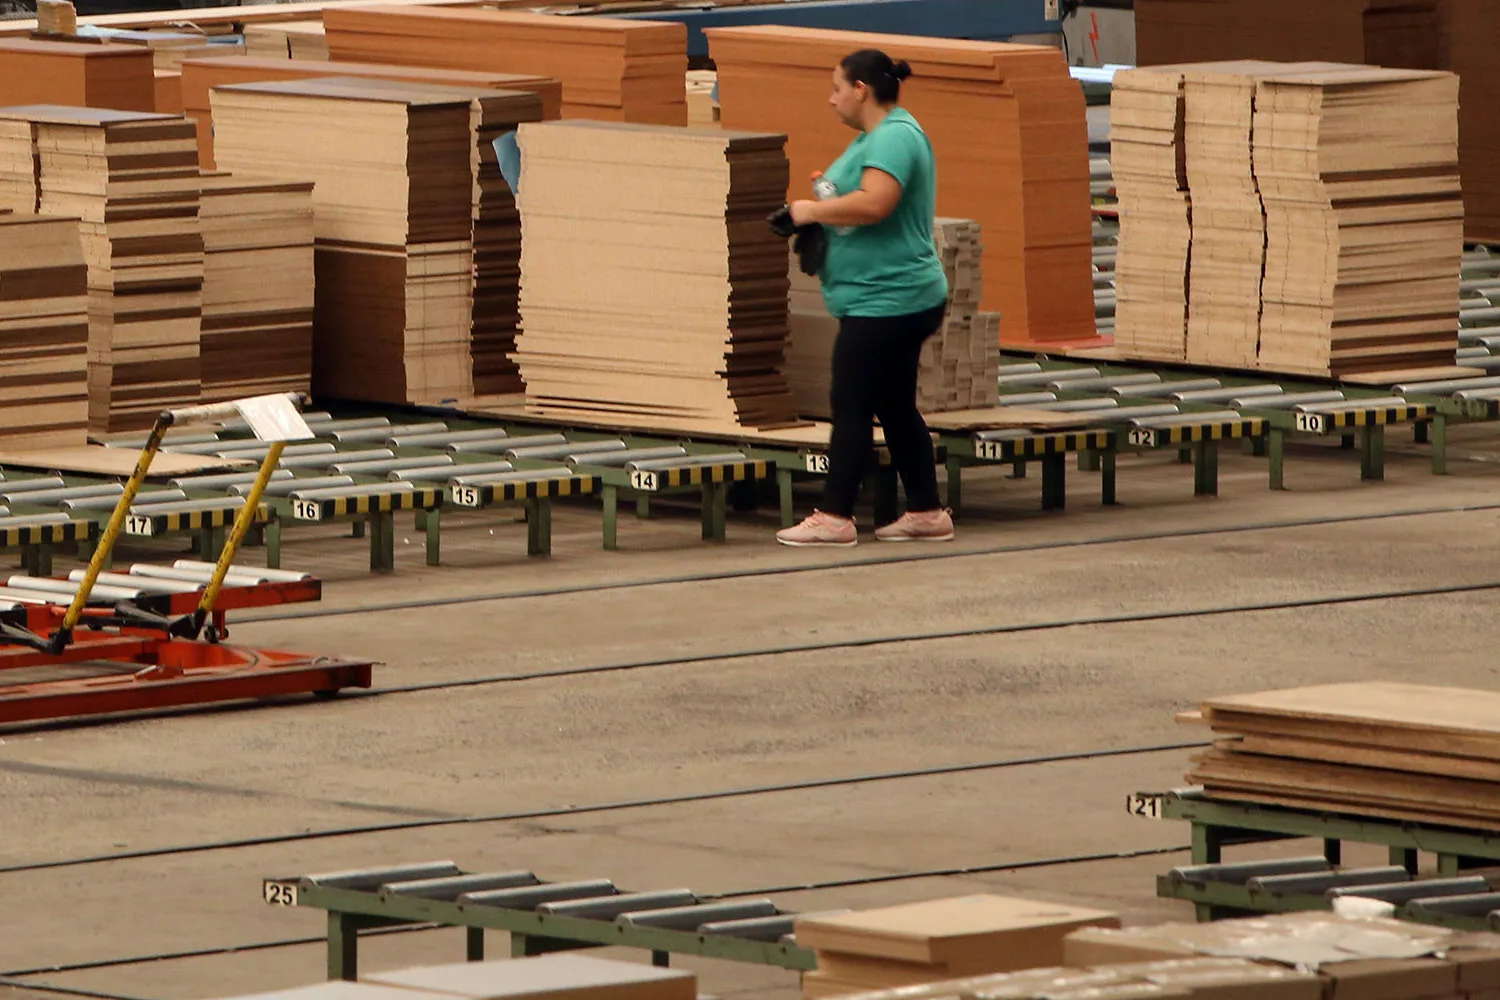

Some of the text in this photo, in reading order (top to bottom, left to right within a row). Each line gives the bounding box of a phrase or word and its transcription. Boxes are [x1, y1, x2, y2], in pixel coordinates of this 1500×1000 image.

[1300, 415, 1318, 430] 10
[1132, 430, 1150, 445] 12
[979, 441, 997, 458] 11
[810, 455, 828, 471] 13
[635, 472, 653, 488] 14
[456, 487, 474, 504] 15
[297, 502, 315, 518] 16
[129, 517, 147, 533] 17
[1135, 797, 1156, 816] 21
[270, 884, 292, 905] 25
